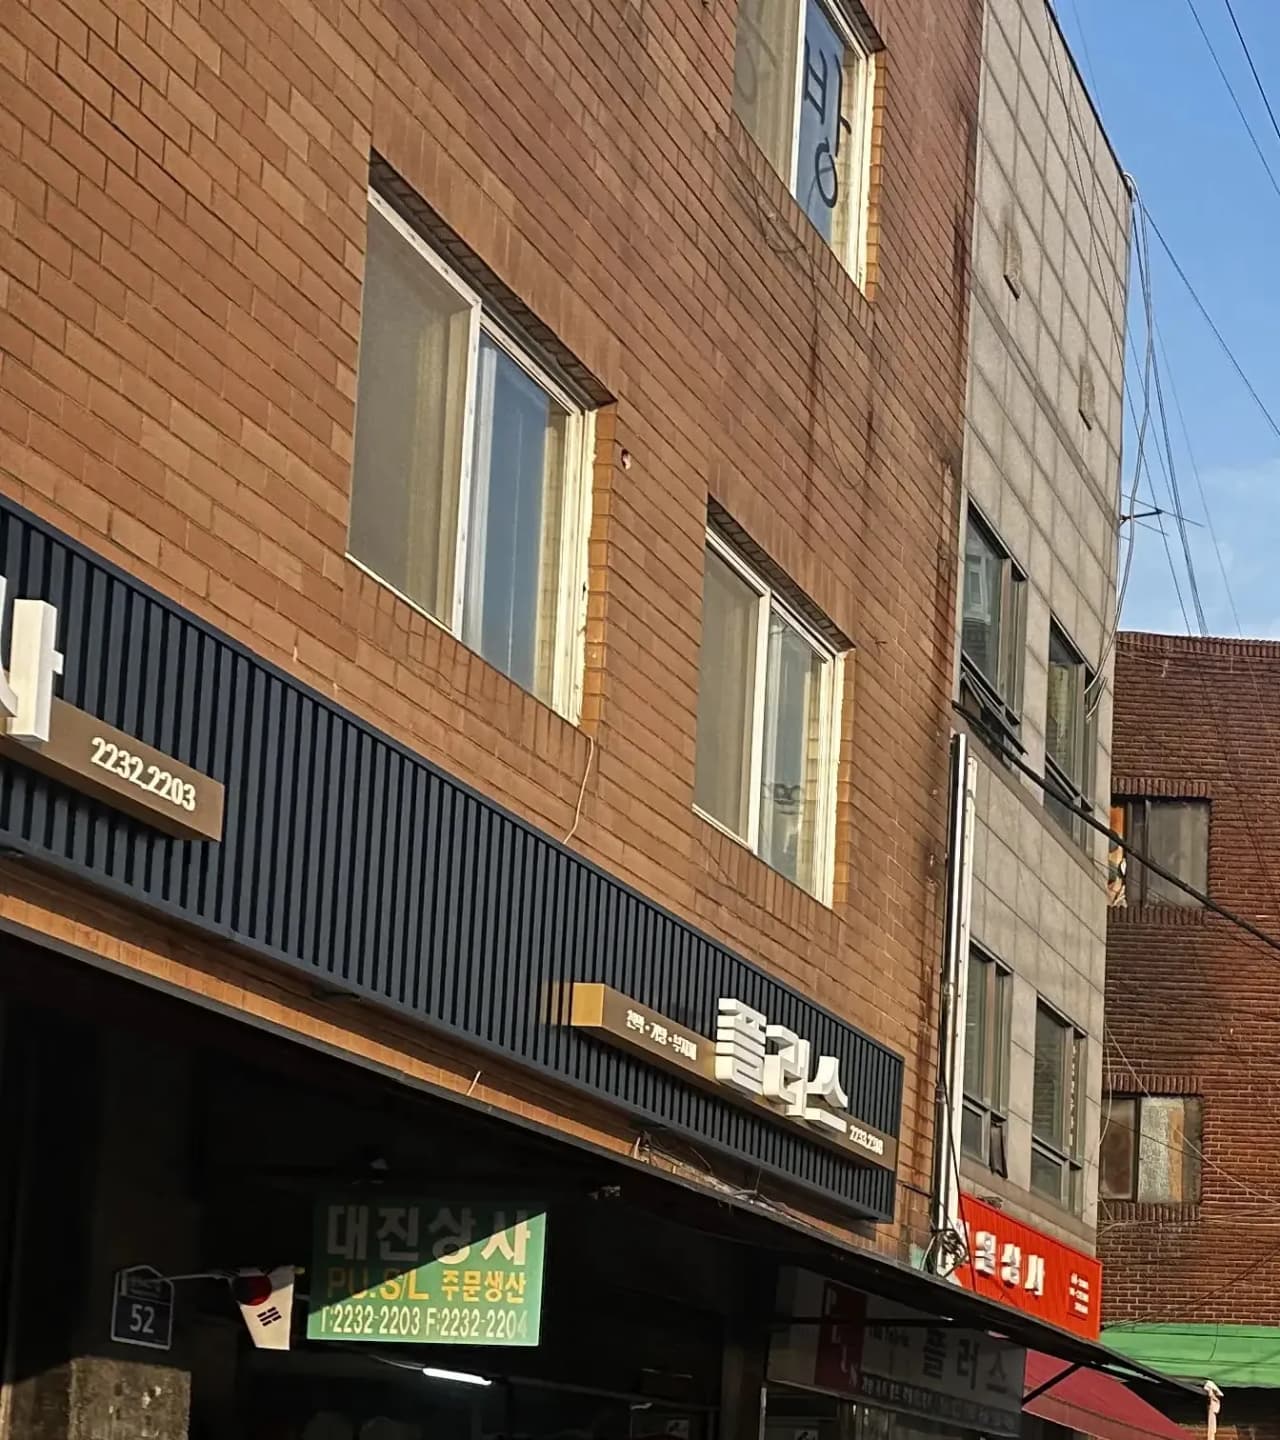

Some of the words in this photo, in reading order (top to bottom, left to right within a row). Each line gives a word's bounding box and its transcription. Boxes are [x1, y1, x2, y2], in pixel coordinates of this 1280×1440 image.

[91, 737, 196, 812] 2232.2203
[715, 997, 849, 1134] 플러스
[327, 1204, 530, 1266] 대진상사
[441, 1270, 527, 1305] 주문생산
[129, 1303, 155, 1335] 52
